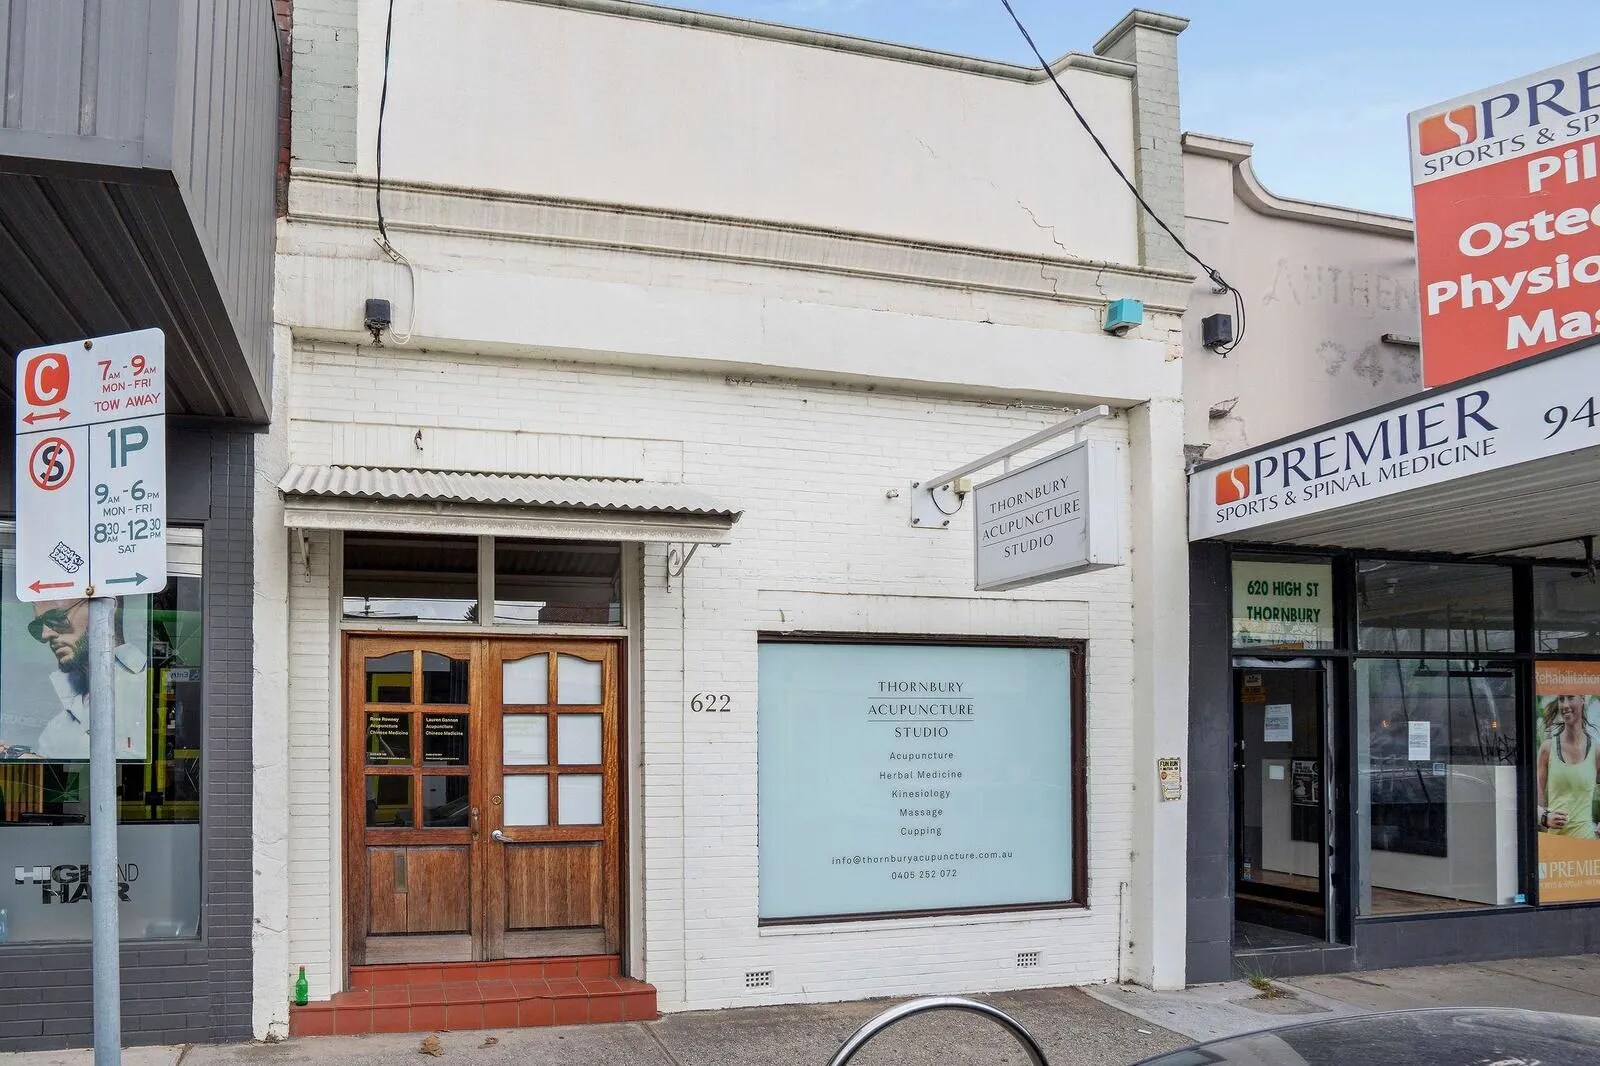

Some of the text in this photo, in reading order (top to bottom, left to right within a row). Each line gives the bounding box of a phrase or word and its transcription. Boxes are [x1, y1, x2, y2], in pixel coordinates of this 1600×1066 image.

[1424, 114, 1600, 176] SPORTS & SP
[1527, 142, 1597, 194] Pil
[1427, 253, 1600, 316] Physio
[1506, 308, 1600, 350] Ma
[34, 358, 59, 400] C
[94, 392, 161, 413] TOW AWAY
[107, 425, 149, 468] 1P
[1255, 390, 1499, 496] PREMIER
[1216, 437, 1497, 524] SPORTS & SPINAL MEDICINE
[989, 475, 1069, 515] THORNBURY
[982, 498, 1081, 542] ACUPUNCTURE
[117, 543, 137, 554] SAT
[1004, 533, 1054, 559] STUDIO
[1247, 580, 1319, 597] 620 HIGH ST
[1246, 605, 1321, 622] THORNBURY
[878, 681, 964, 693] THORNBURY
[690, 692, 731, 713] 622
[867, 704, 975, 716] ACUPUNCTURE
[894, 727, 949, 738] STUDIO
[889, 752, 954, 761] Acupuncture
[879, 770, 963, 780] Herbal Medicine
[891, 789, 951, 799] Kinesiology
[899, 808, 944, 818] Massage
[900, 826, 943, 837] Cupping
[831, 851, 1013, 866] info@thornburyacupuncture.com.au
[891, 869, 957, 880] 0405 252 072
